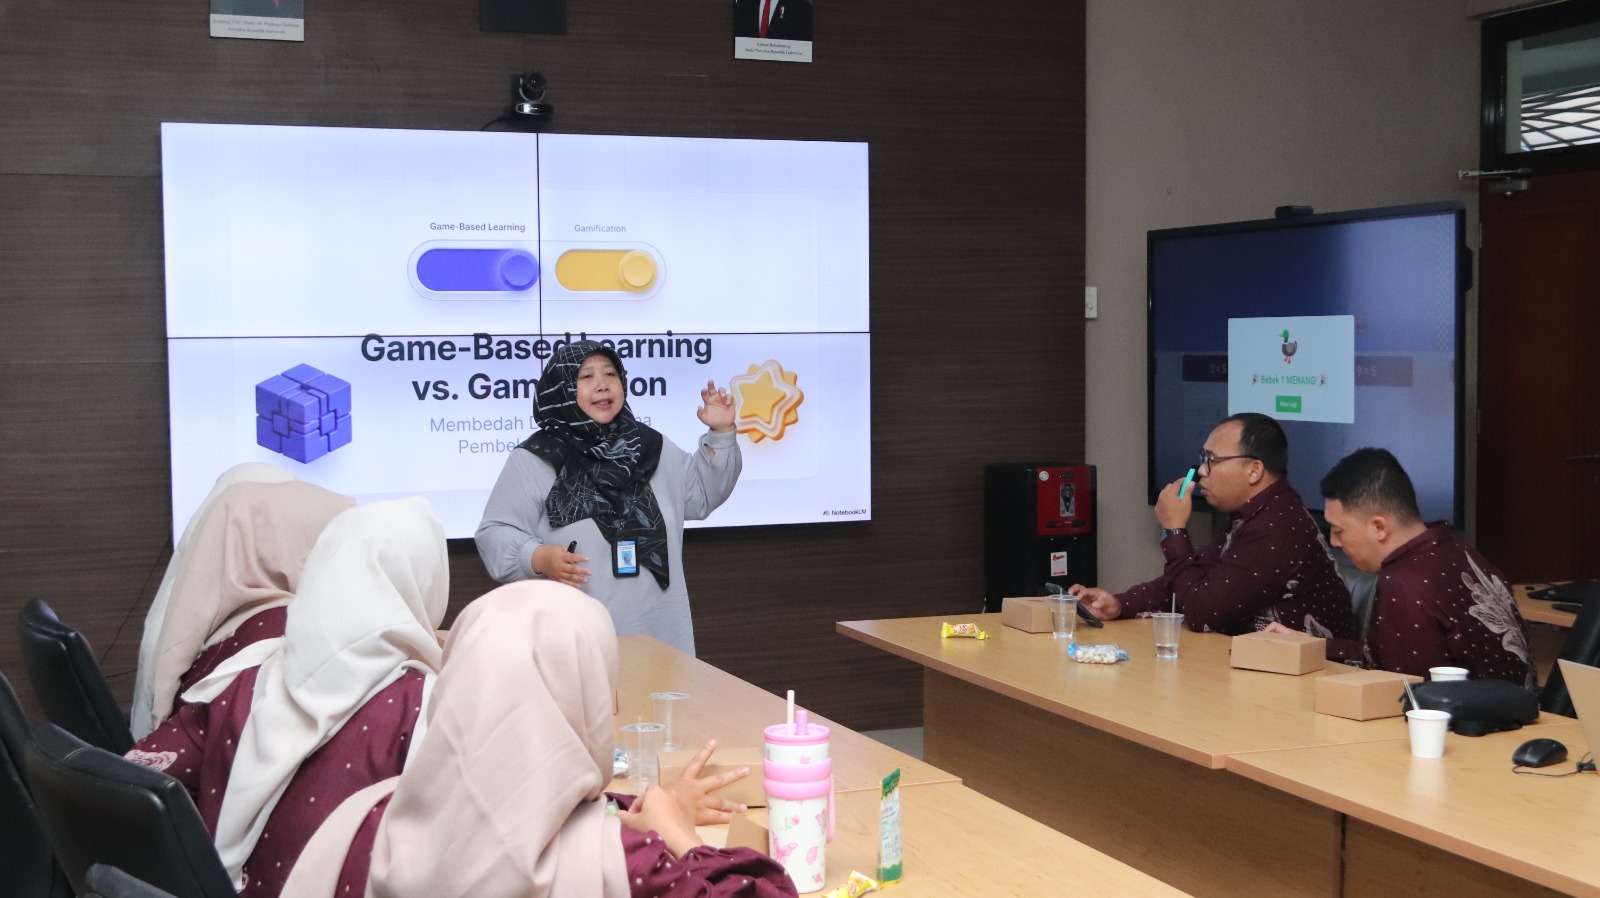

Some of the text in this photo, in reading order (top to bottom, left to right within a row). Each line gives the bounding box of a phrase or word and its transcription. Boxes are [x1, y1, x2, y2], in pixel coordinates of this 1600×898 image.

[429, 222, 526, 233] Game-Based Learning
[574, 224, 627, 232] Gamification
[1260, 374, 1280, 384] Bebek
[412, 380, 458, 400] vs.
[430, 416, 524, 432] Membedah
